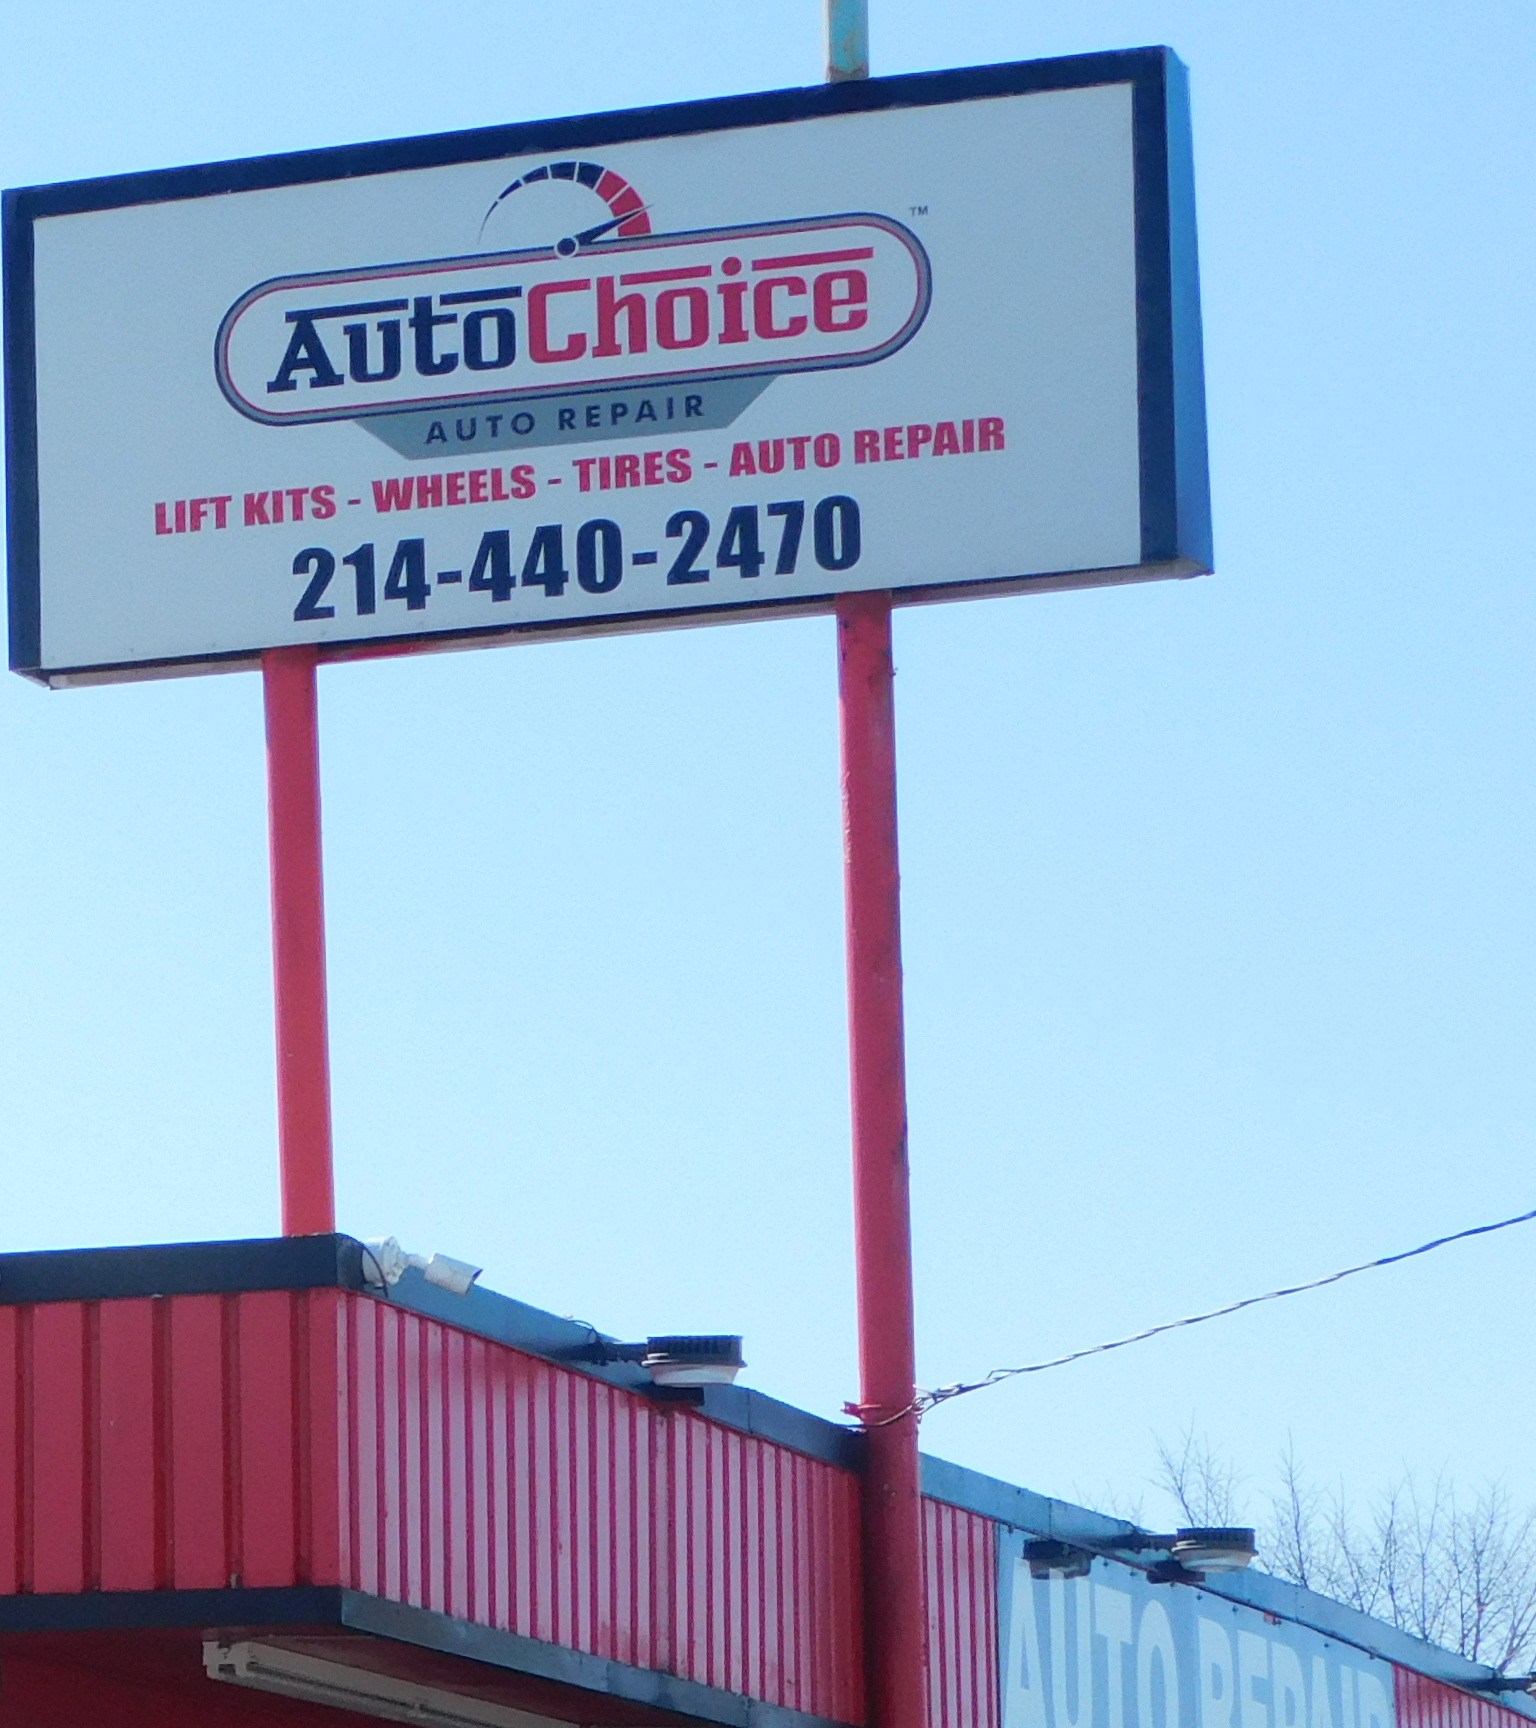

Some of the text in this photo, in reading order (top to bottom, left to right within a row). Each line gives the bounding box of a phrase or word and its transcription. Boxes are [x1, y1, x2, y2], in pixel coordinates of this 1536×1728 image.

[909, 205, 929, 217] TM
[424, 394, 704, 444] AUTO REPAIR
[155, 495, 232, 535] LIFT
[244, 485, 336, 526] KITS
[372, 464, 536, 513] WHEELS
[572, 448, 692, 492] TIRES
[729, 433, 840, 477] AUTO
[854, 416, 1005, 464] REPAIR
[292, 495, 861, 622] 214-440-2470
